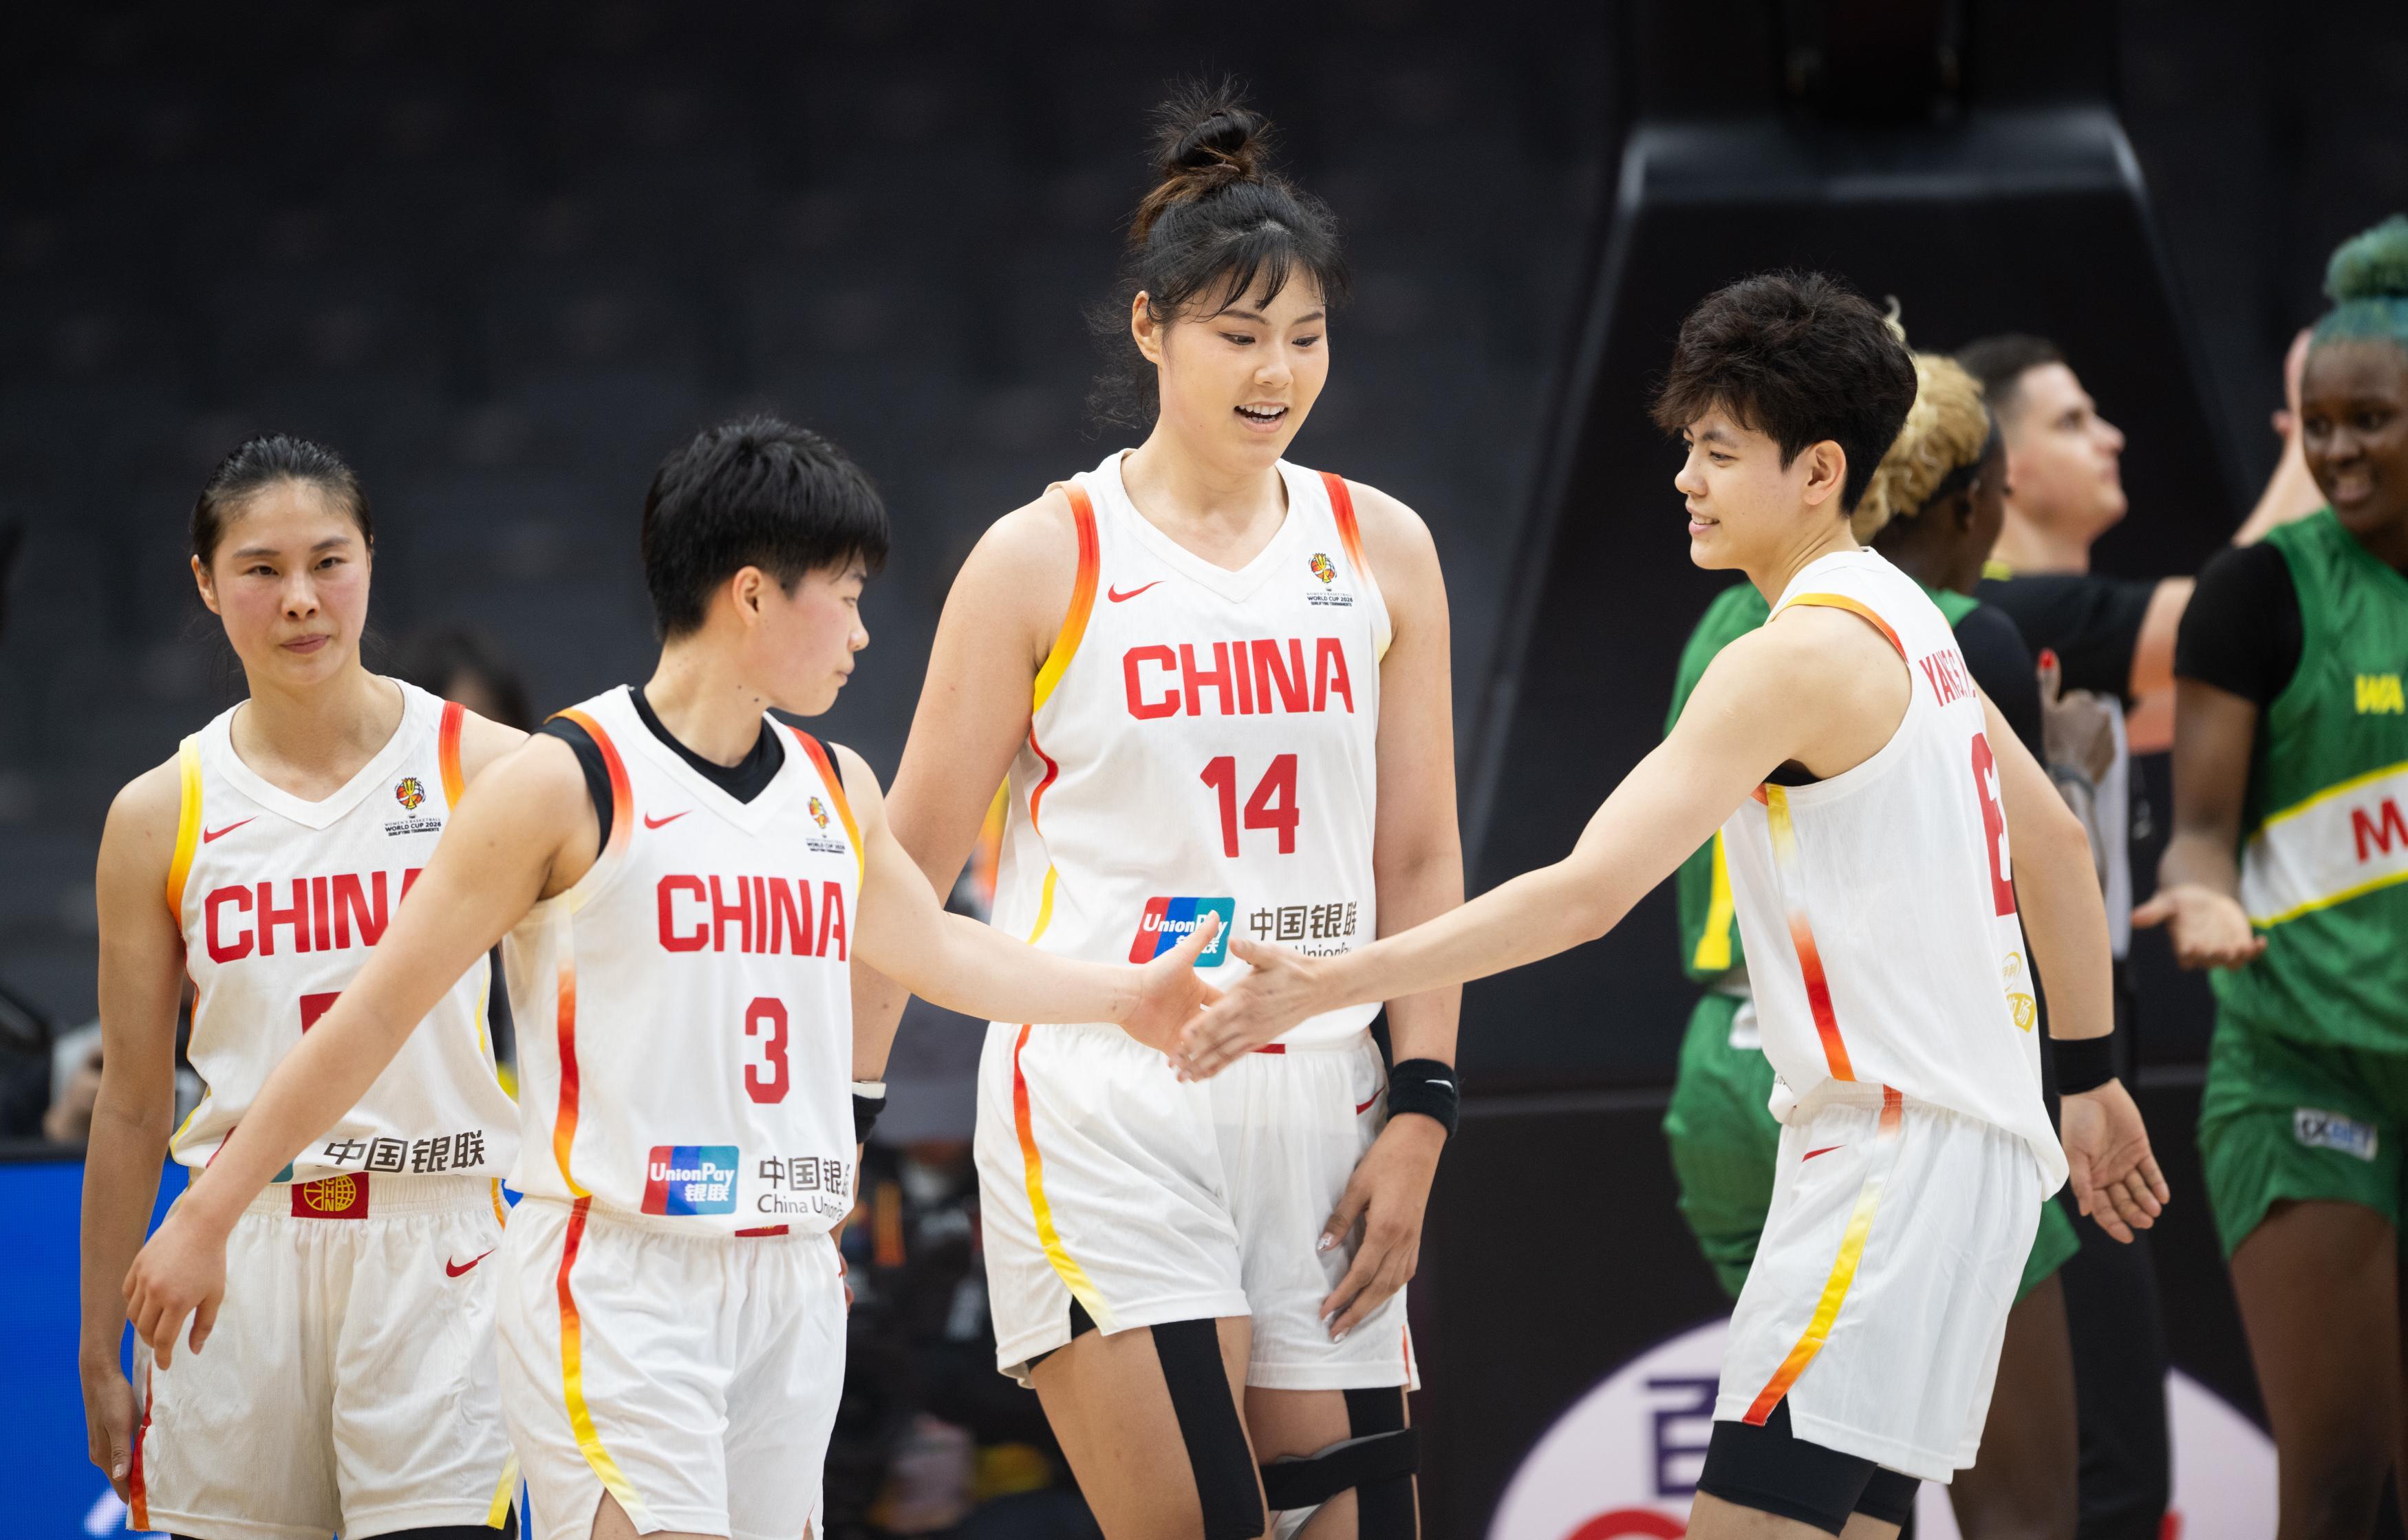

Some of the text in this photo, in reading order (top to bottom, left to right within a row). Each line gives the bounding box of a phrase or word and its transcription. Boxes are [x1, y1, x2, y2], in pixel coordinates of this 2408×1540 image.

[1124, 638, 1353, 720] CHINA
[1200, 754, 1299, 857] 14
[658, 875, 846, 961] CHINA
[1143, 913, 1229, 939] UnionPy
[1250, 901, 1357, 941] 中国银联
[744, 997, 788, 1104] 3
[323, 1129, 484, 1173] 中国银联
[650, 1162, 735, 1188] UnionPay
[684, 1183, 730, 1202] 银联
[757, 1194, 808, 1213] China
